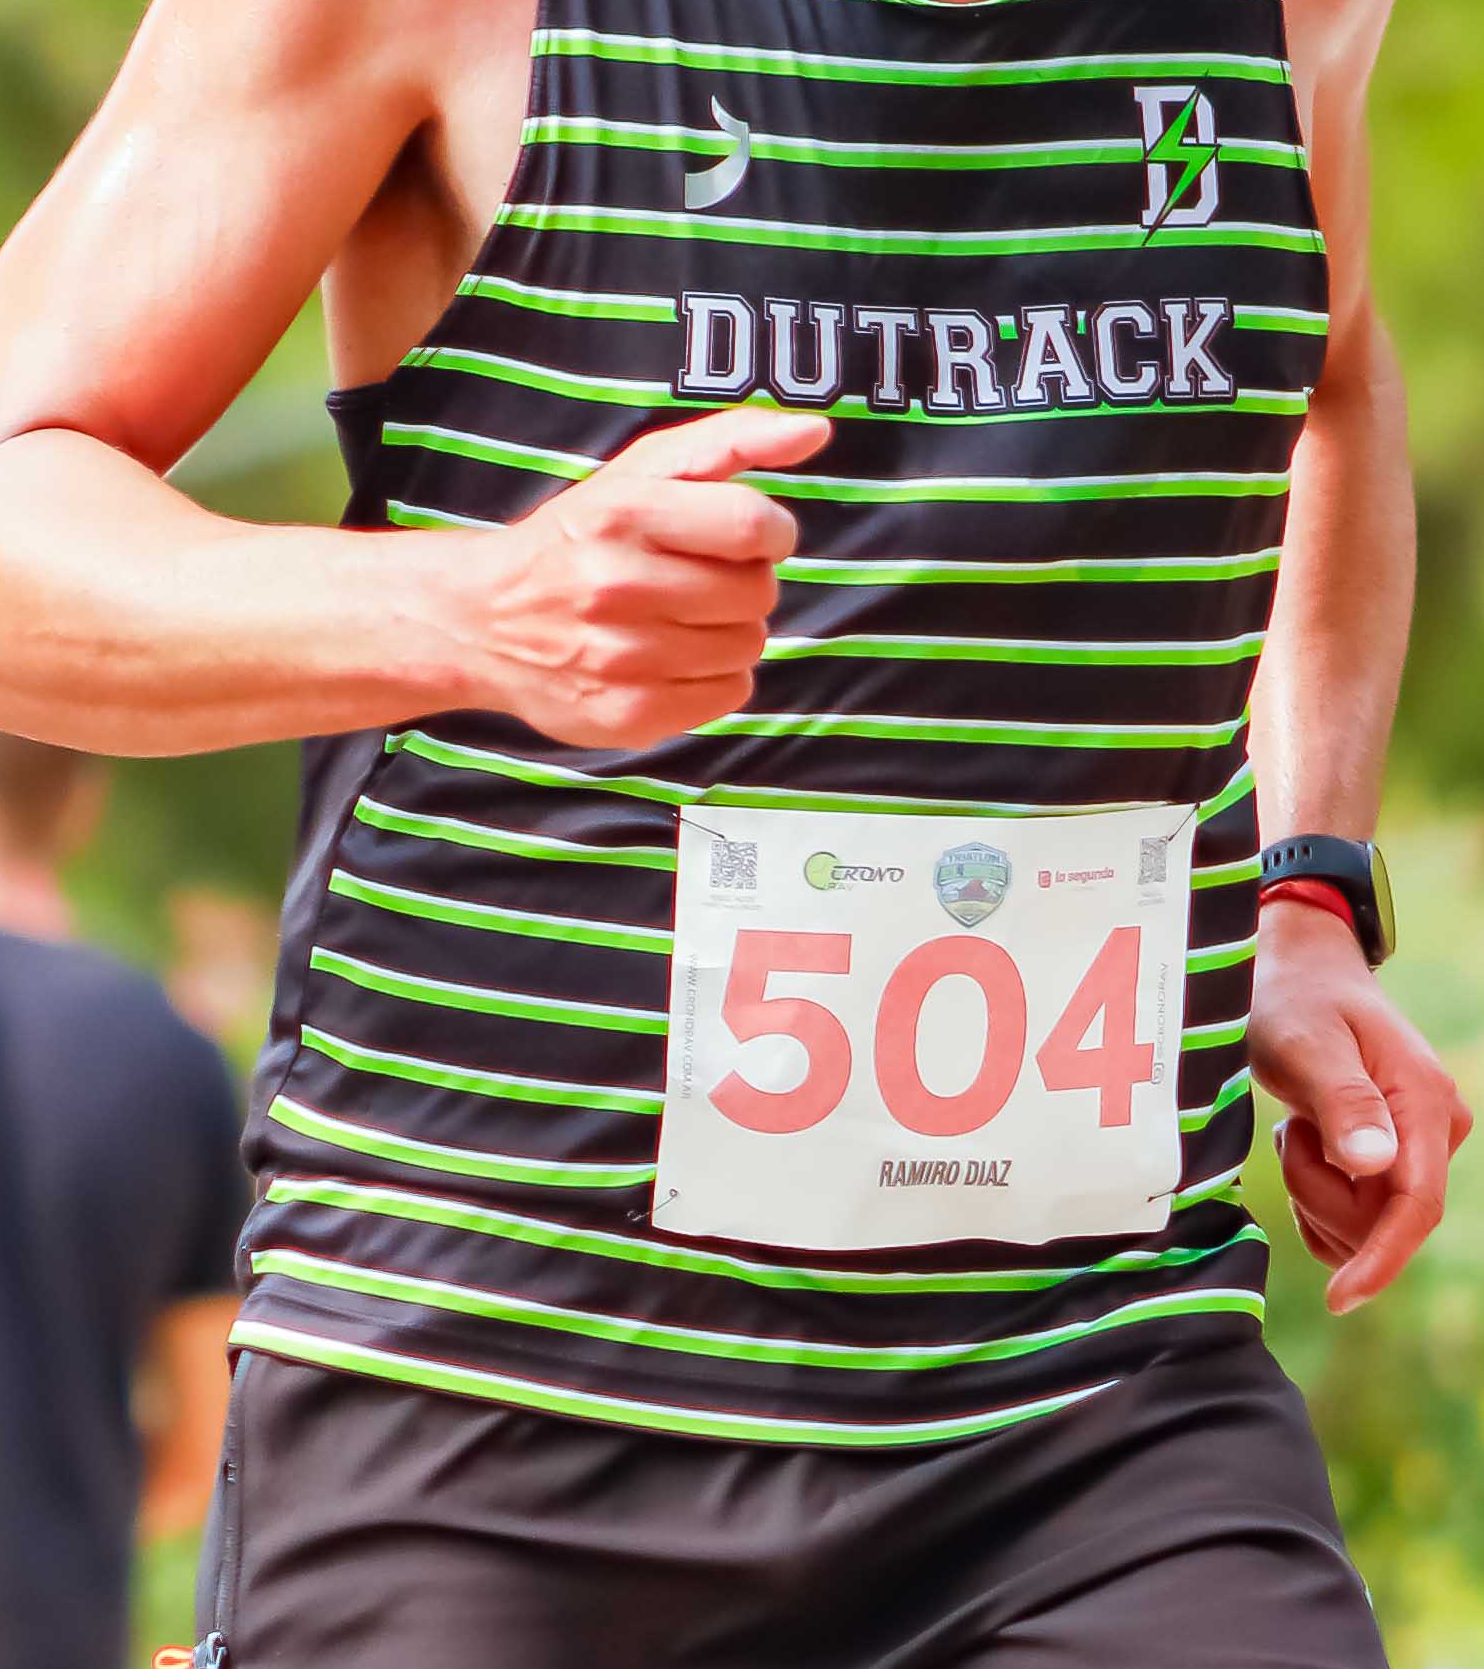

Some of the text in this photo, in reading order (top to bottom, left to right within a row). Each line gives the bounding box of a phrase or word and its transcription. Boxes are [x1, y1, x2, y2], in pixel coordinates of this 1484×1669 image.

[675, 292, 1236, 410] DUTRACK
[707, 926, 1154, 1137] 504
[879, 1159, 1013, 1187] RAMIRO DIAZ
